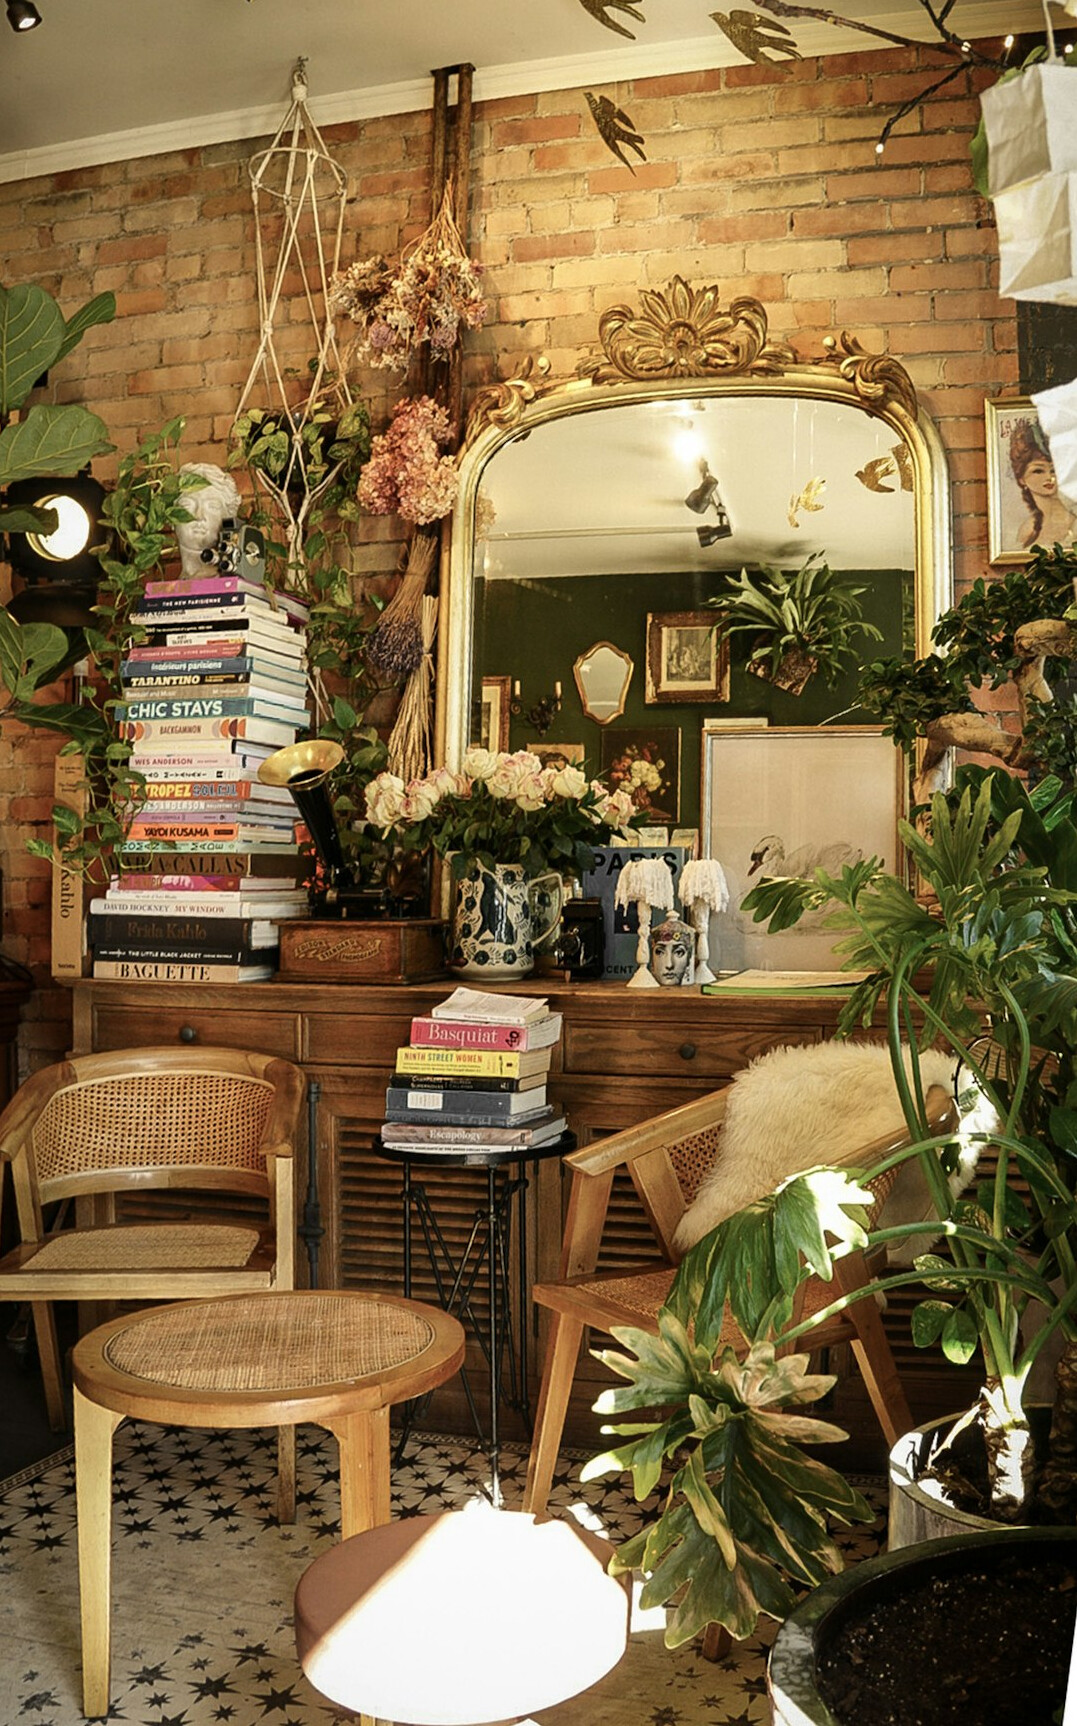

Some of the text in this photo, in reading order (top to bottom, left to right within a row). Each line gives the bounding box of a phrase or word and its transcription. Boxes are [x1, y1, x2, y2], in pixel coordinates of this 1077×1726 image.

[187, 661, 222, 672] parisiens
[130, 675, 201, 687] TARANTINO
[128, 700, 223, 718] CHIC STAYS
[160, 725, 202, 735] BACKGAMMON
[143, 827, 168, 837] YAYOI
[169, 827, 210, 837] KUSAMA
[190, 842, 224, 851] MADE
[173, 856, 246, 873] CALLAS
[589, 852, 677, 876] PAS
[103, 903, 226, 913] DAVID HOCKNEY MY WINDOW
[127, 921, 207, 940] Frida Kahlo
[120, 963, 211, 980] BAGUETTE
[428, 1023, 499, 1046] Basquiat
[404, 1052, 484, 1063] NINTH STREET WOMEN
[428, 1129, 483, 1141] Escapology
